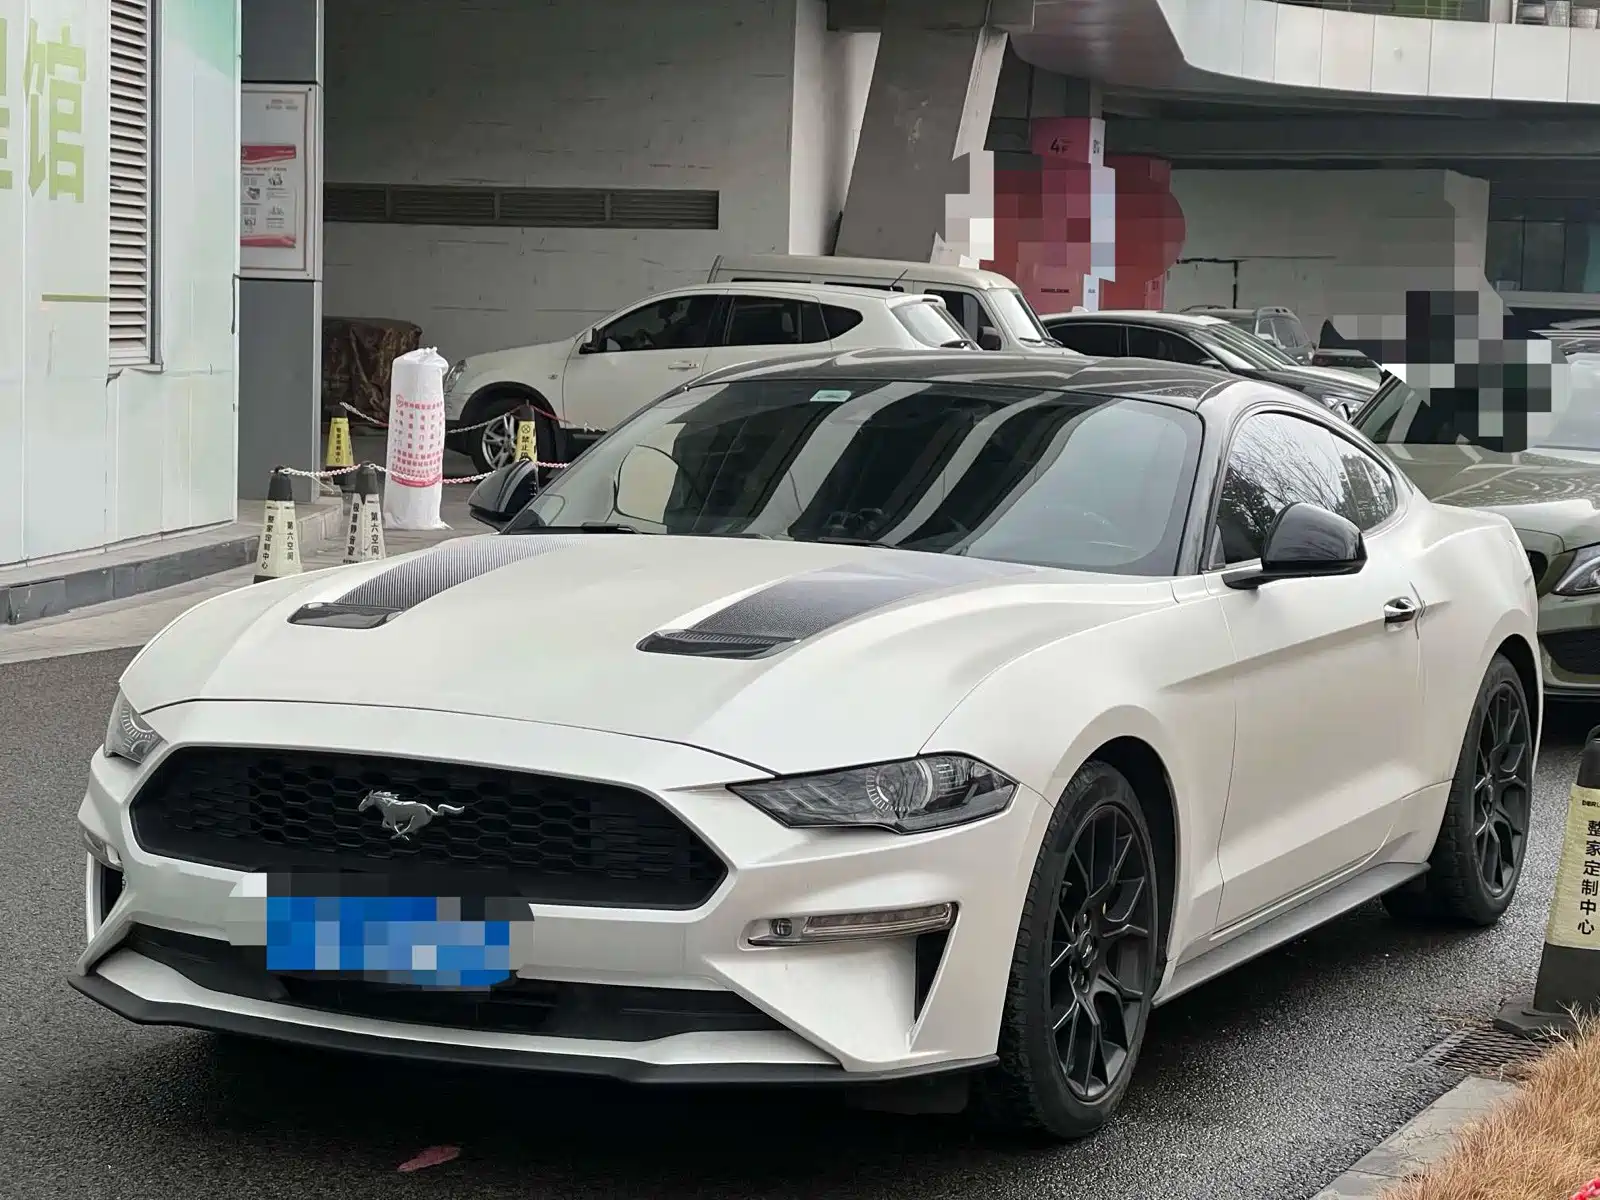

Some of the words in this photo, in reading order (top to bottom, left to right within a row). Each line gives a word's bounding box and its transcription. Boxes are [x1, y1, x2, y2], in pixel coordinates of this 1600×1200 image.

[1577, 819, 1600, 936] 整家定制中心
